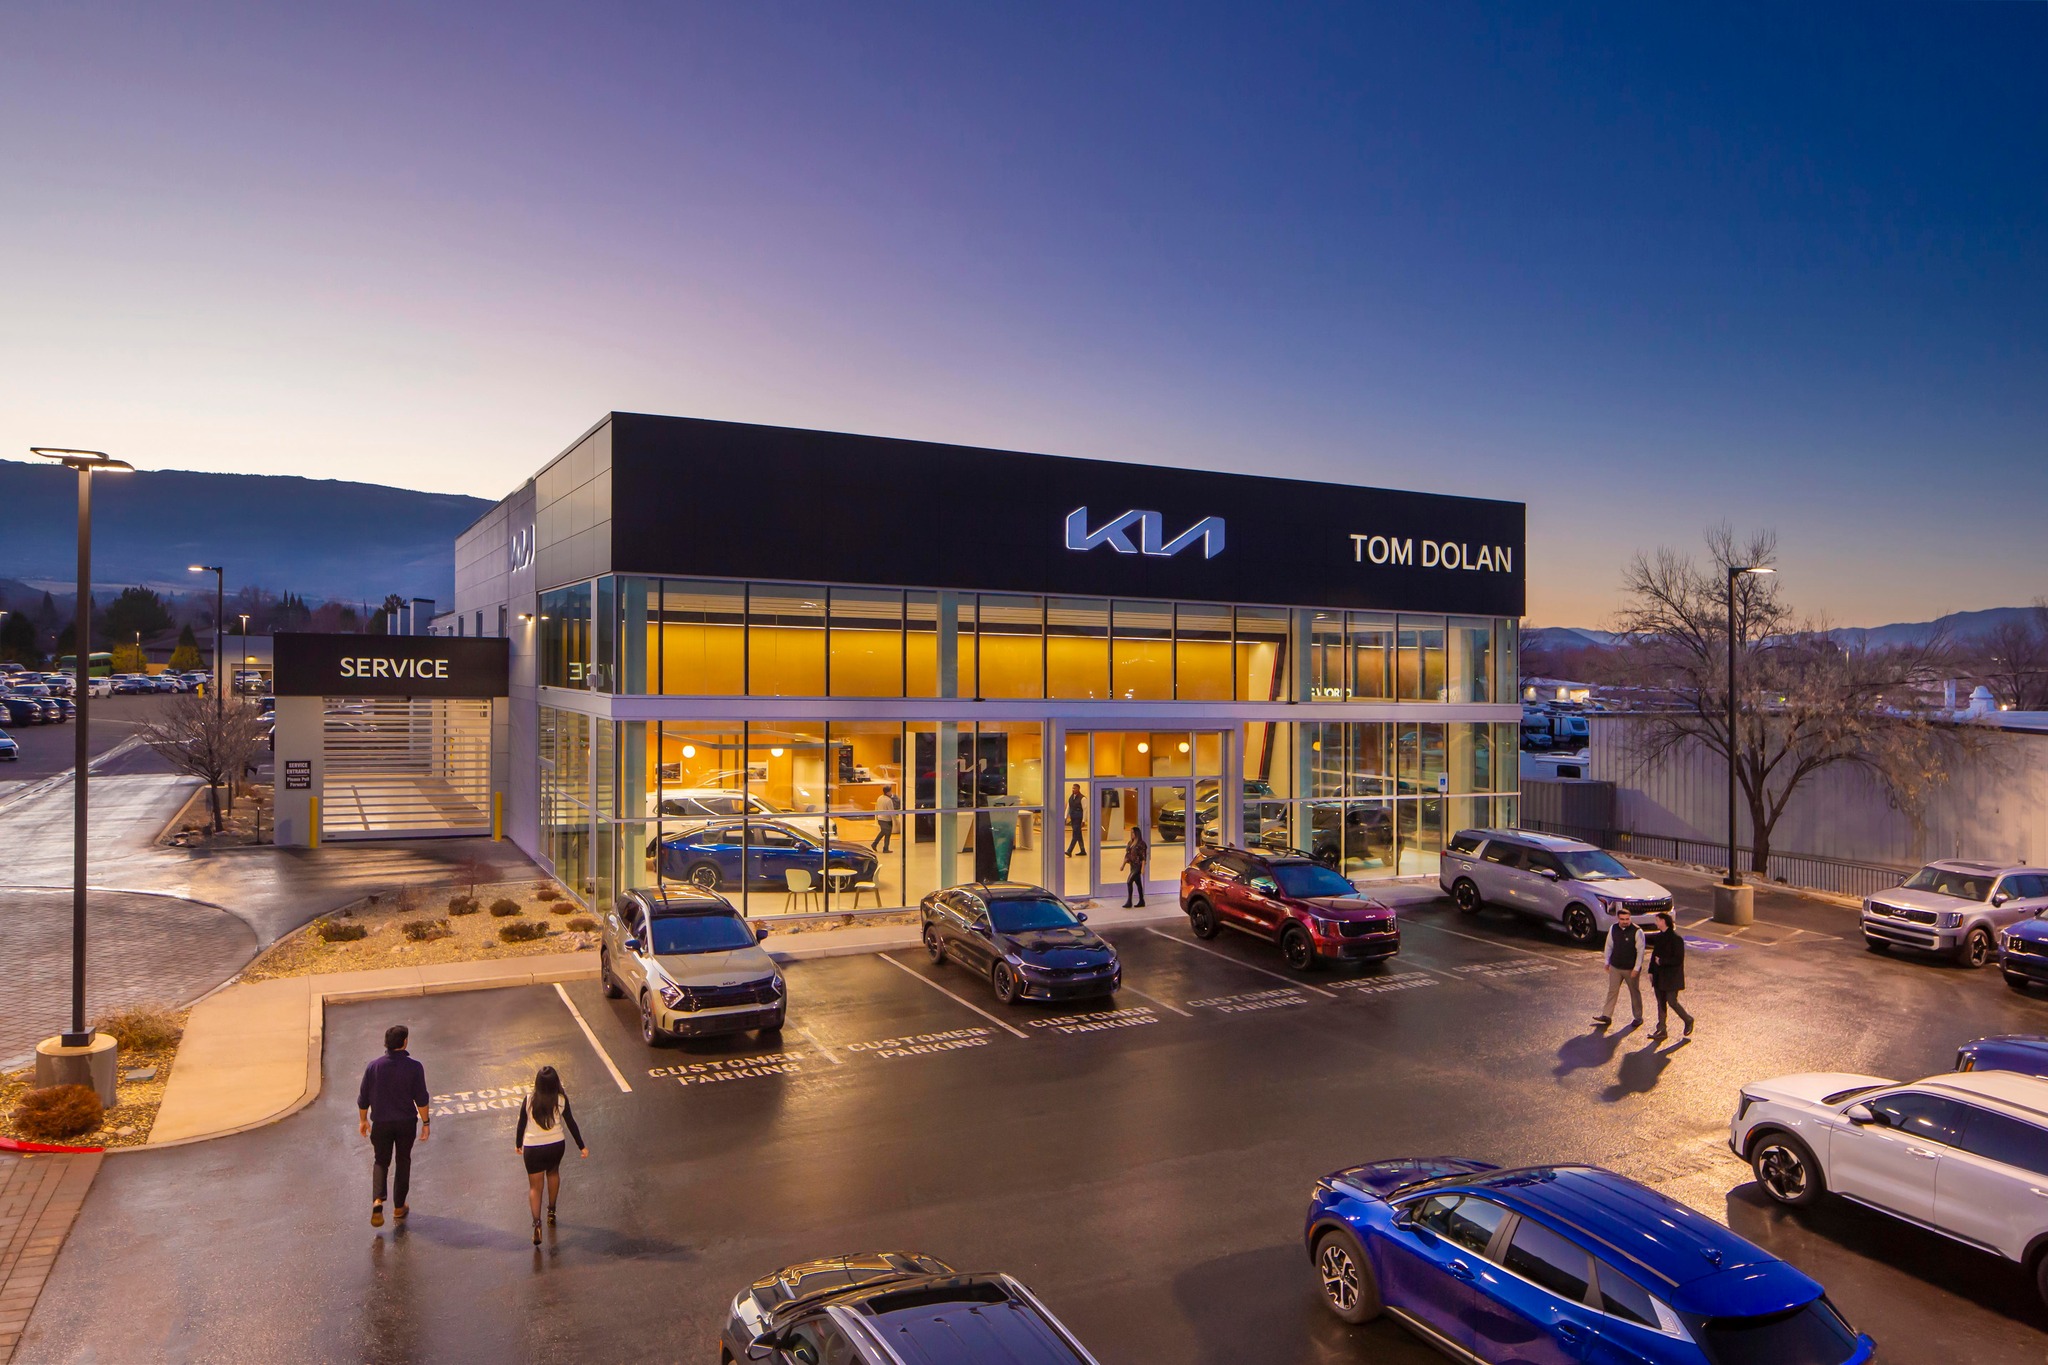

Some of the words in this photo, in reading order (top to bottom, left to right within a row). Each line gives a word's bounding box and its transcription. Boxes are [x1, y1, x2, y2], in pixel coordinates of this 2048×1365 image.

[1065, 506, 1226, 560] KIA
[1350, 533, 1413, 566] TOM
[1422, 539, 1512, 573] DOLAN
[340, 657, 449, 679] SERVICE
[1186, 988, 1301, 1008] CUSTOMER
[1028, 1006, 1155, 1028] CUSTOMER
[1057, 1015, 1159, 1034] PARKING
[847, 1027, 991, 1052] CUSTOMER
[877, 1037, 988, 1059] PARKING
[648, 1051, 806, 1078] CUSTOMER
[677, 1062, 801, 1086] PARKING
